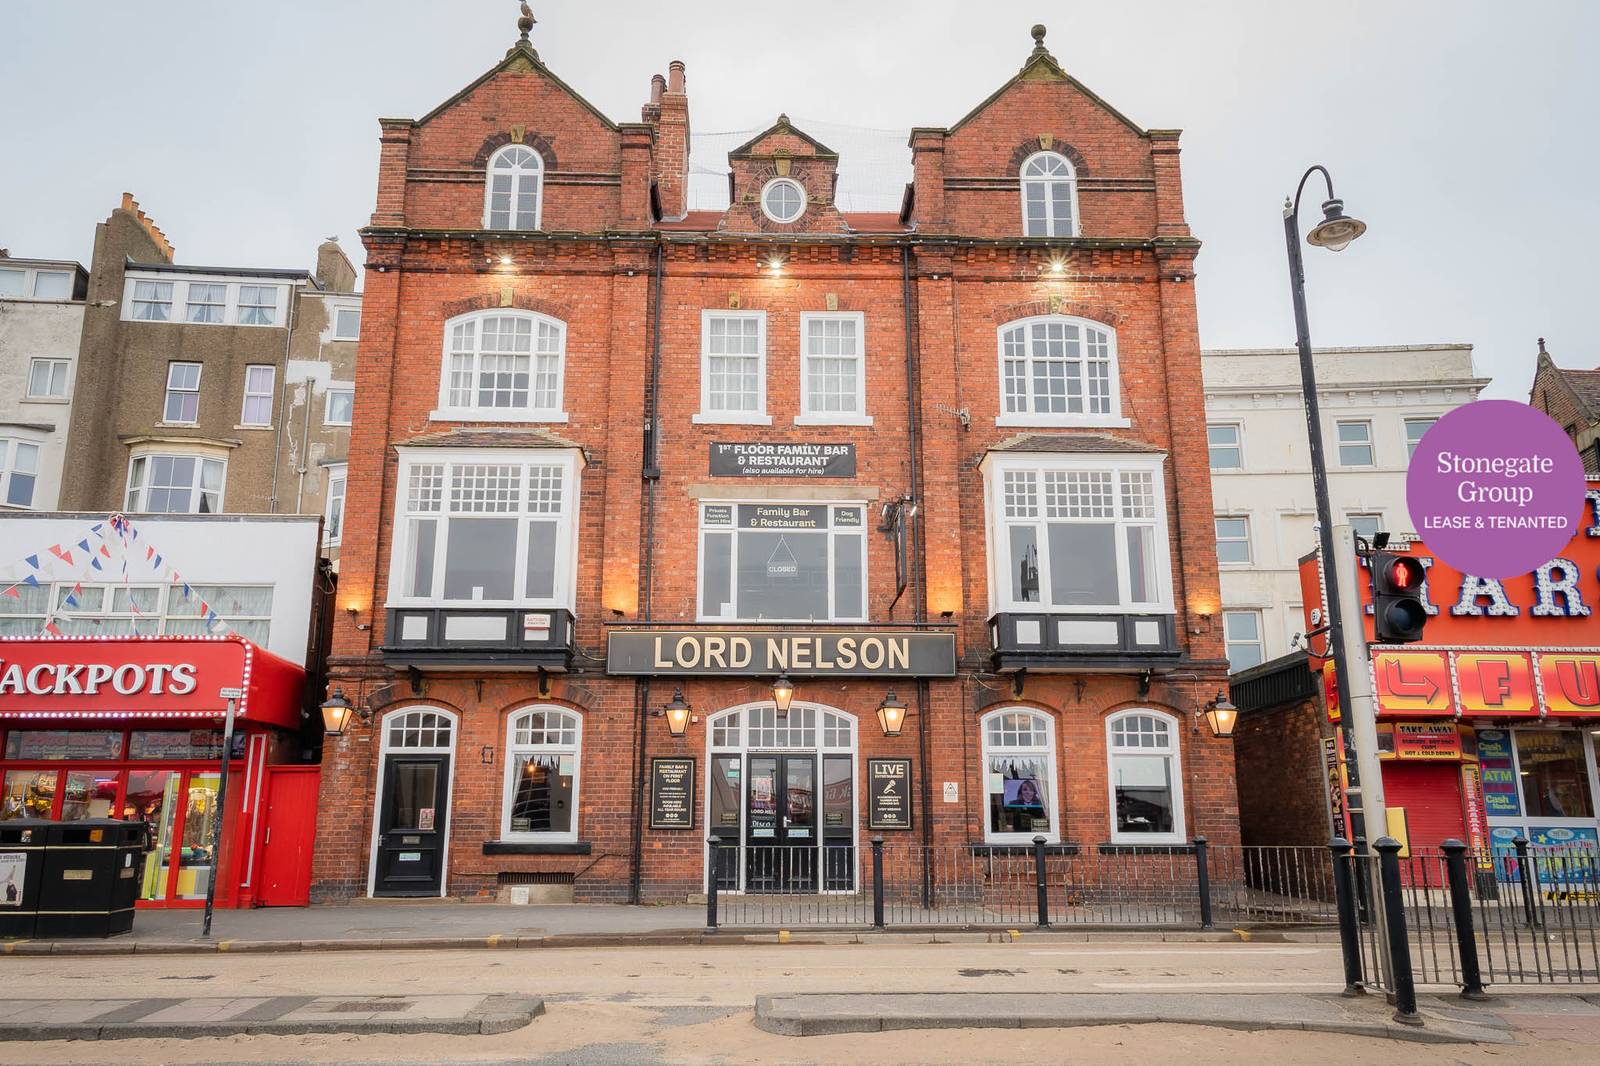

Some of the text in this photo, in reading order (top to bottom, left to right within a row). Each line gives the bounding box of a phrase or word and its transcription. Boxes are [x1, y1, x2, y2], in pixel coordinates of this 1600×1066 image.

[734, 445, 774, 455] FLOOR
[777, 445, 820, 455] FAMILY
[824, 446, 849, 456] BAR
[737, 456, 829, 466] & RESTAURANT
[742, 467, 825, 475] (also available for hire)
[756, 507, 810, 518] Family Bar
[750, 518, 816, 527] & Restaurant
[654, 636, 910, 669] LORD NELSON
[0, 658, 197, 695] ACKPOTS
[875, 764, 904, 775] LIVE
[1484, 770, 1512, 781] ATM
[1486, 795, 1509, 803] Cash
